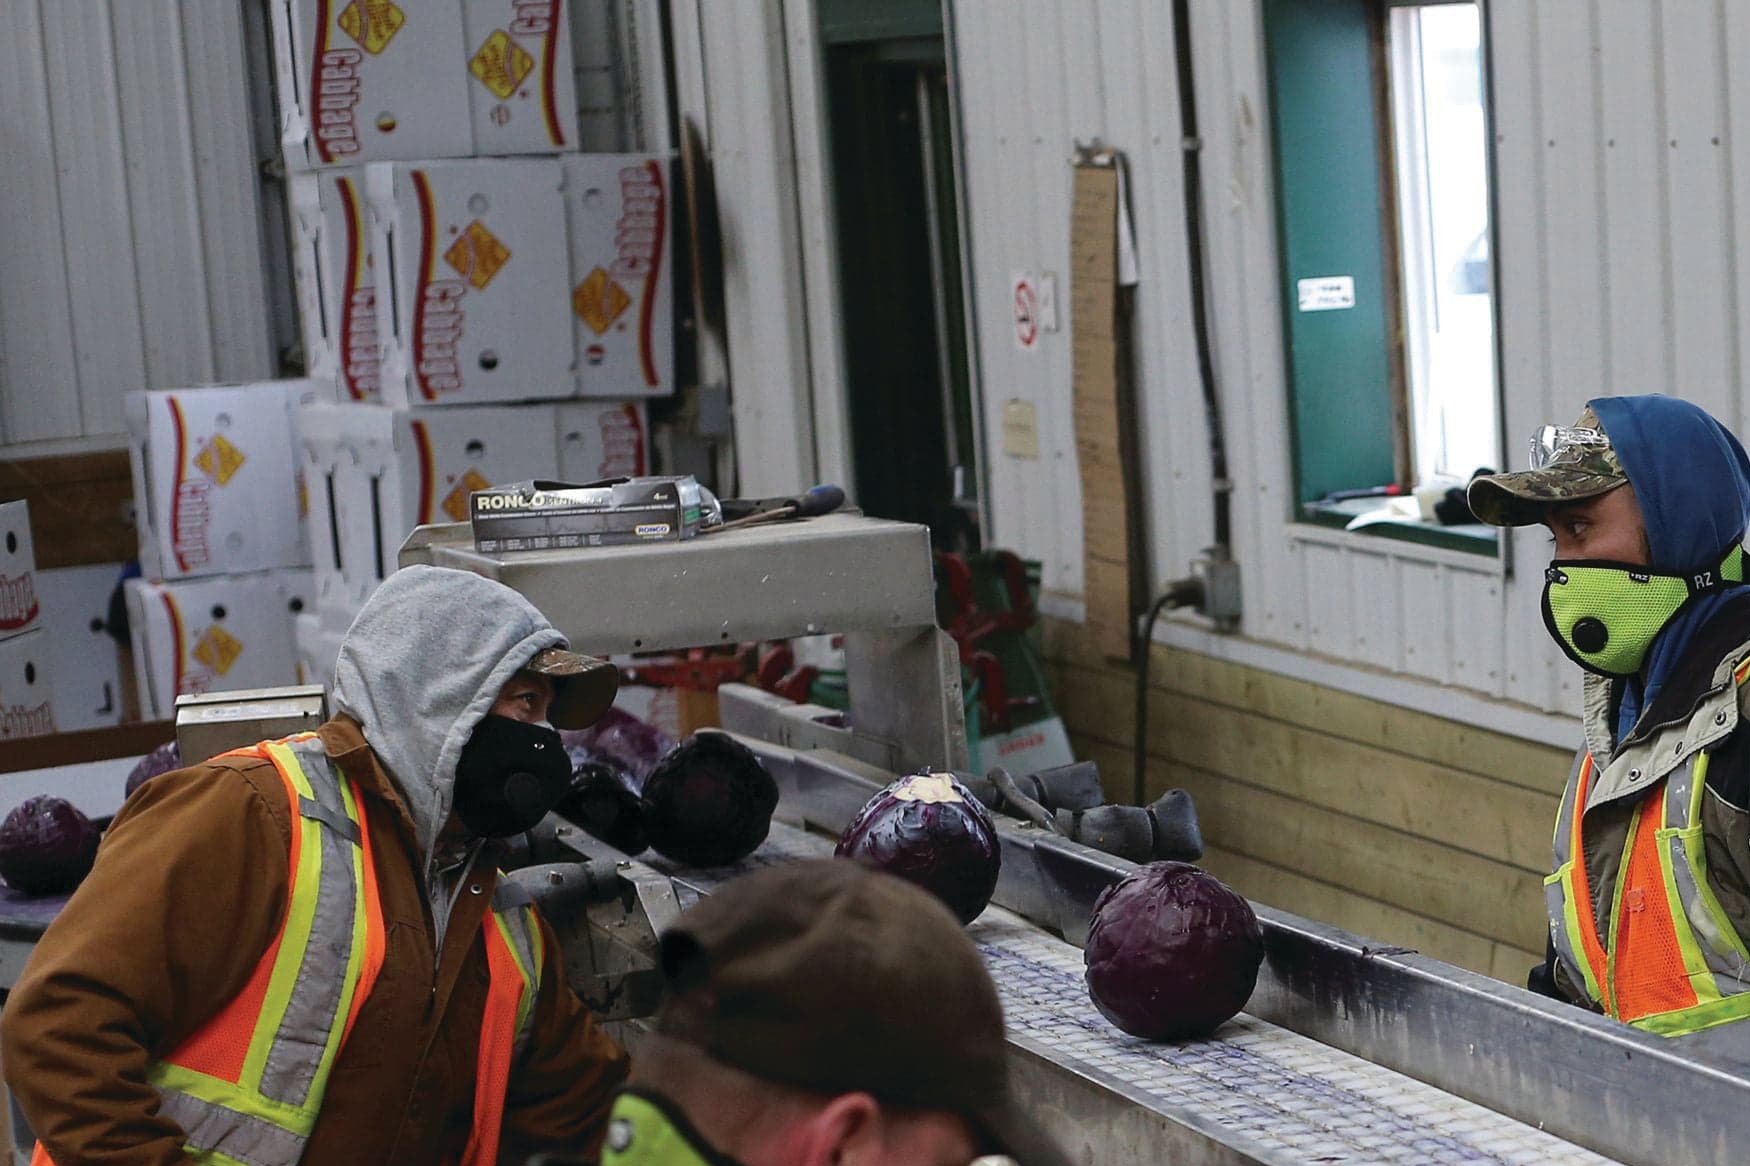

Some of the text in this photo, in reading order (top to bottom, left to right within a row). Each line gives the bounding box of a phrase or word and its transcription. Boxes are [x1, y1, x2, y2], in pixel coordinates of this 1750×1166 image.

[319, 48, 361, 155] Cabbage
[608, 166, 661, 280] Cabbage
[420, 279, 468, 391] Cabbage
[477, 491, 545, 511] RONCO
[638, 526, 668, 534] RONCO
[1694, 571, 1714, 591] RZ
